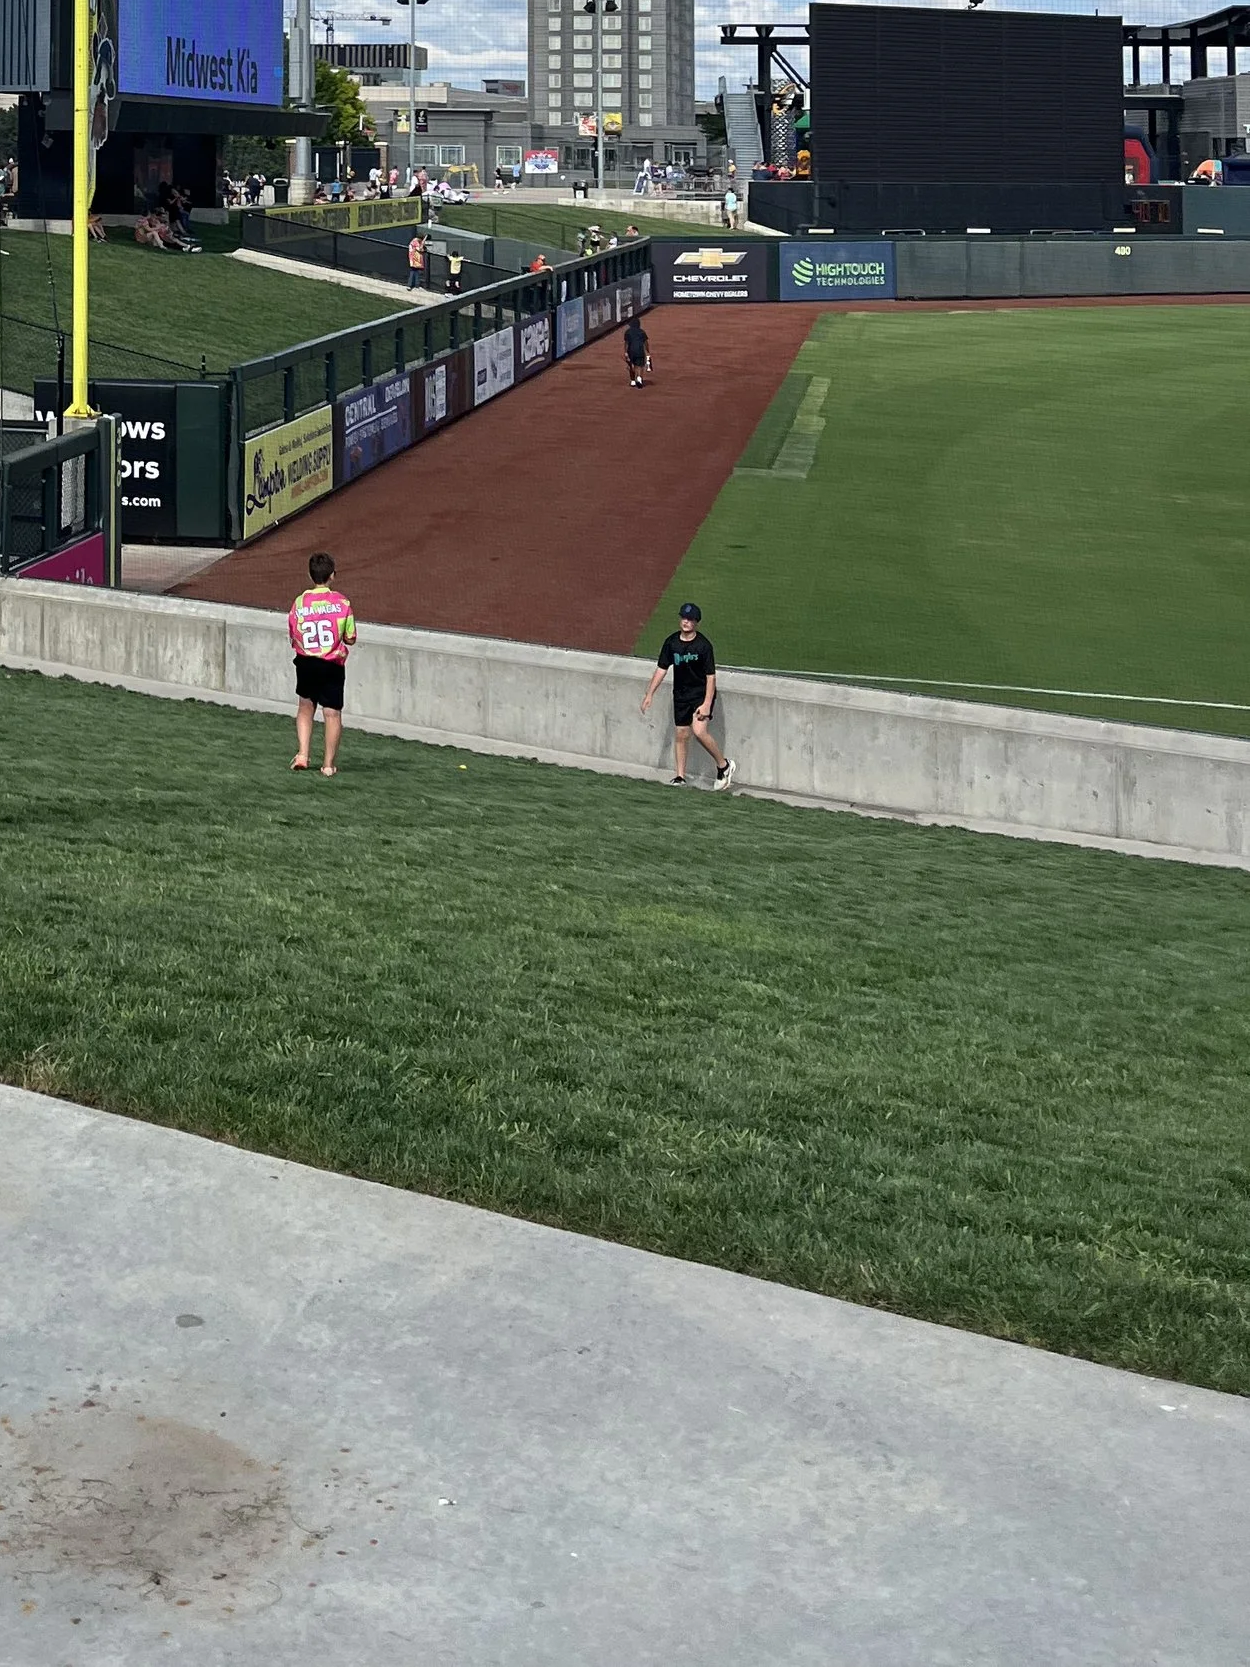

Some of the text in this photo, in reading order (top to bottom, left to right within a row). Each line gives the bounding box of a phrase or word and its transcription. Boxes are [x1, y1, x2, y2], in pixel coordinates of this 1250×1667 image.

[166, 36, 259, 94] Midwest Kia
[816, 262, 885, 276] HIGHTOUCH
[673, 274, 748, 282] CHEVROLET
[816, 275, 885, 286] TECHNOLOGIES
[302, 619, 335, 649] 26
